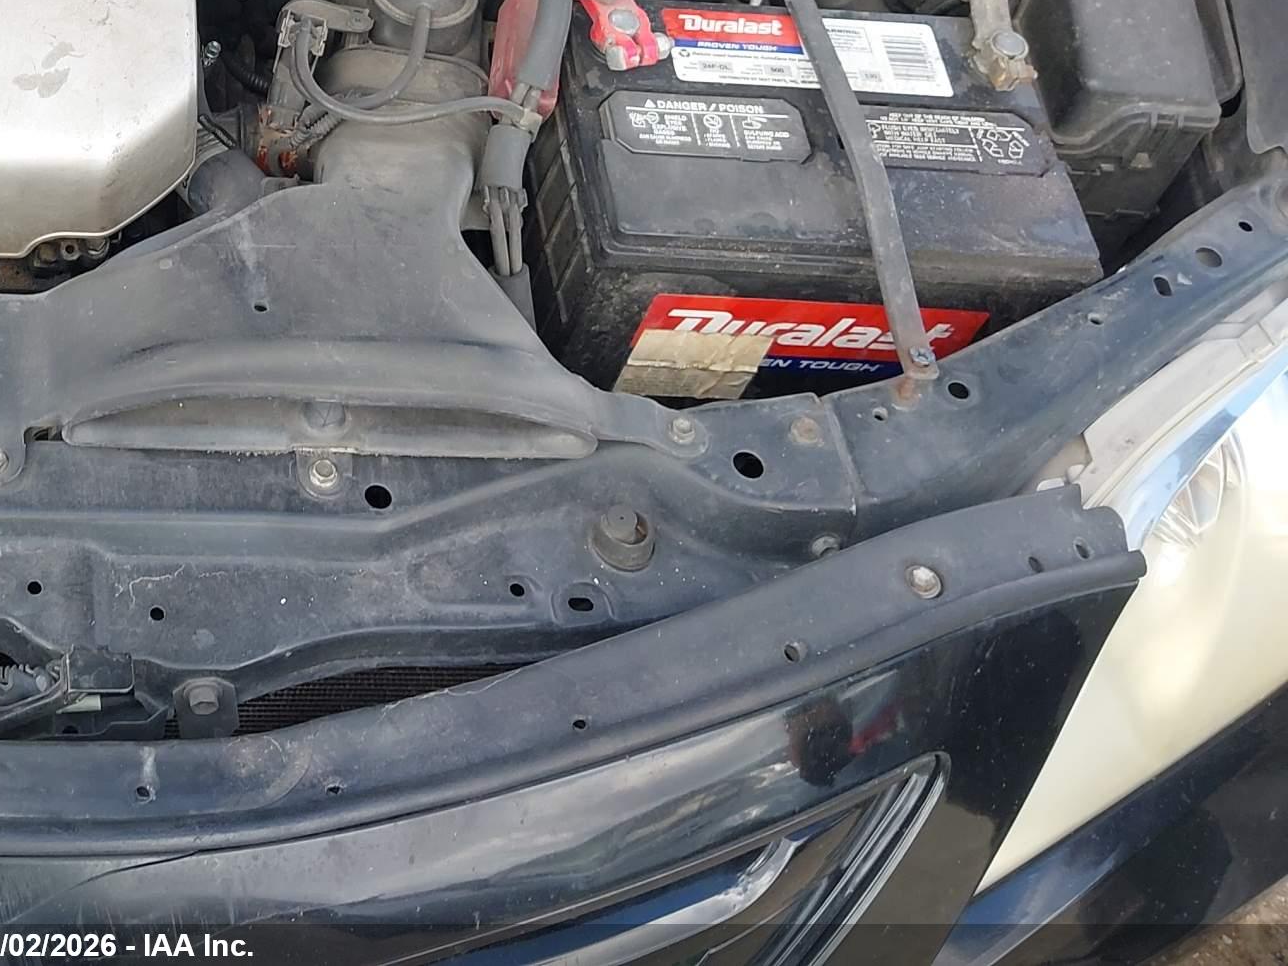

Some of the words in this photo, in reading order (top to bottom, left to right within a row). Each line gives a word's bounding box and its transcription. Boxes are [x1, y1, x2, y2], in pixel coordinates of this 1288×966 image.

[678, 14, 783, 36] Duralast
[697, 41, 740, 50] PROVEN
[742, 43, 778, 52] TOUGH
[656, 99, 708, 111] DANGER
[718, 103, 764, 114] POISON
[799, 359, 880, 372] TOUGH
